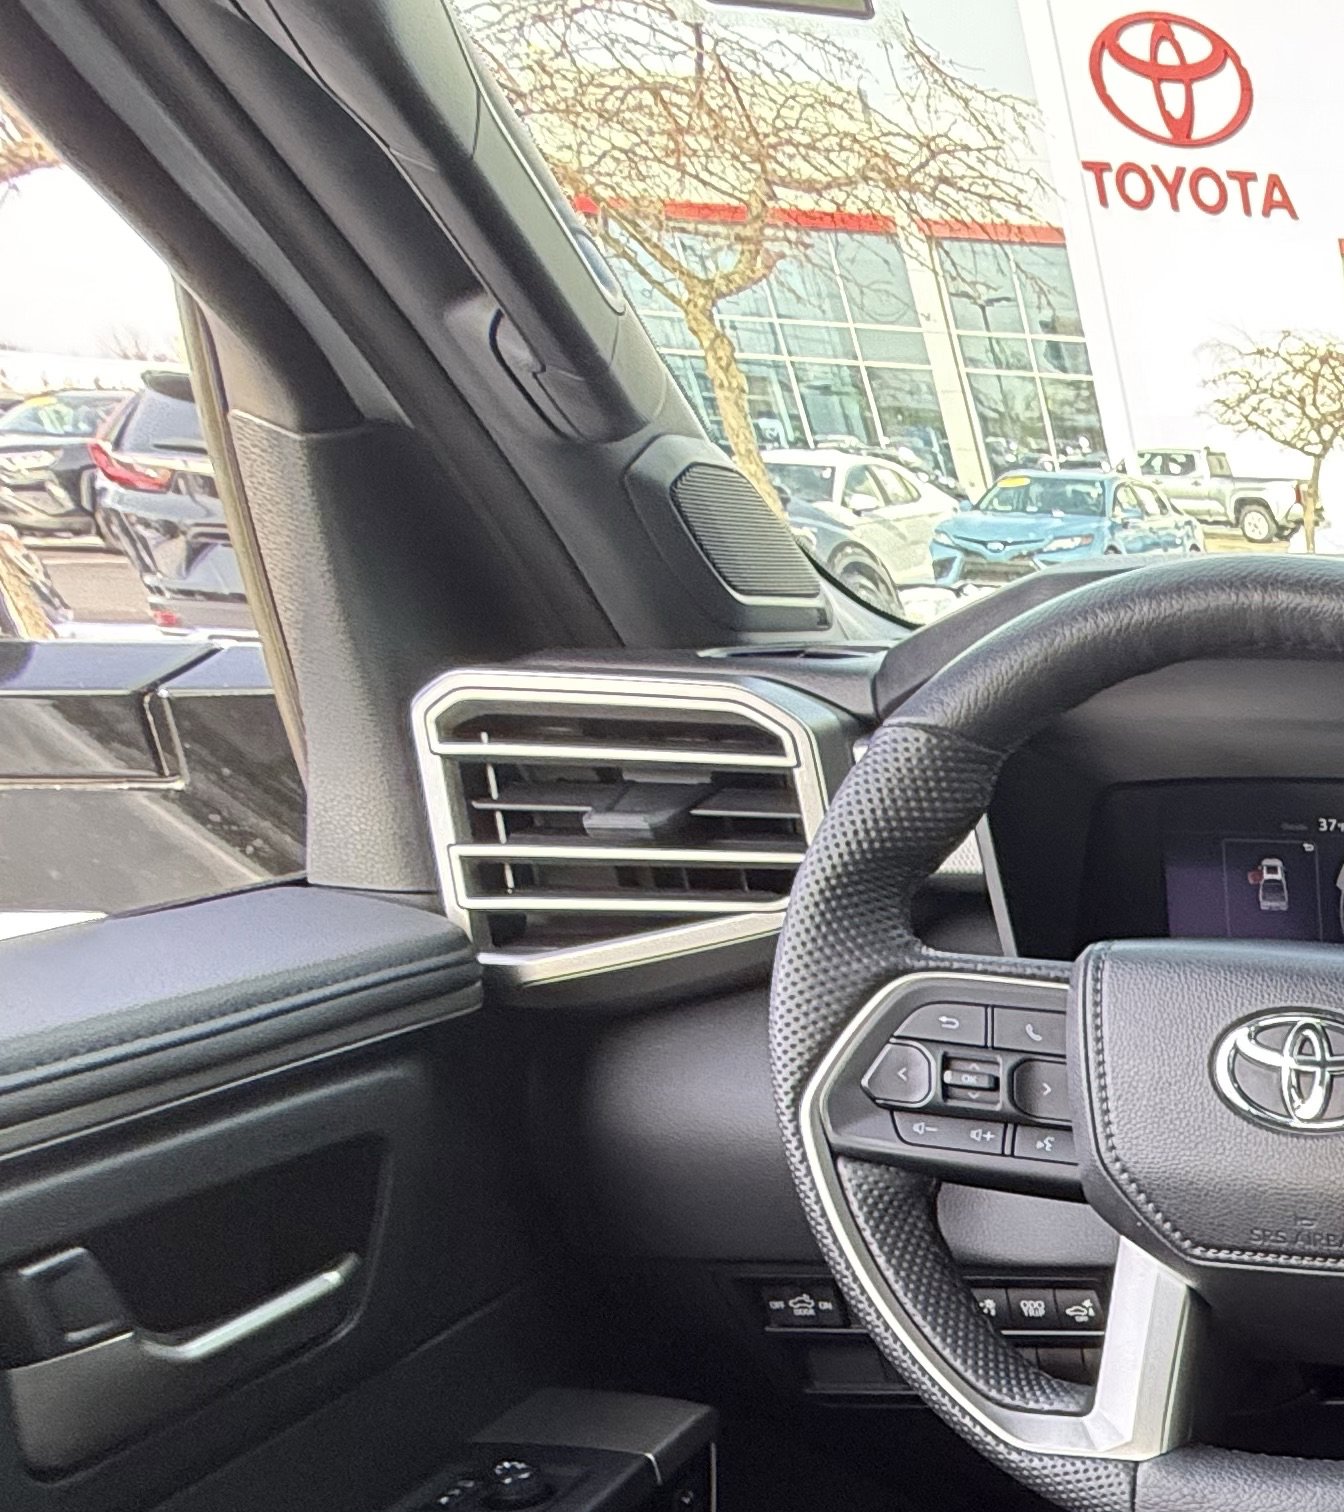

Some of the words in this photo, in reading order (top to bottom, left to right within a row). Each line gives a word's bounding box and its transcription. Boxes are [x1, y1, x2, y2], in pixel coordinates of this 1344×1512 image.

[1081, 160, 1300, 221] TOYOTA
[961, 1074, 978, 1085] OK
[1250, 1227, 1289, 1247] SRS
